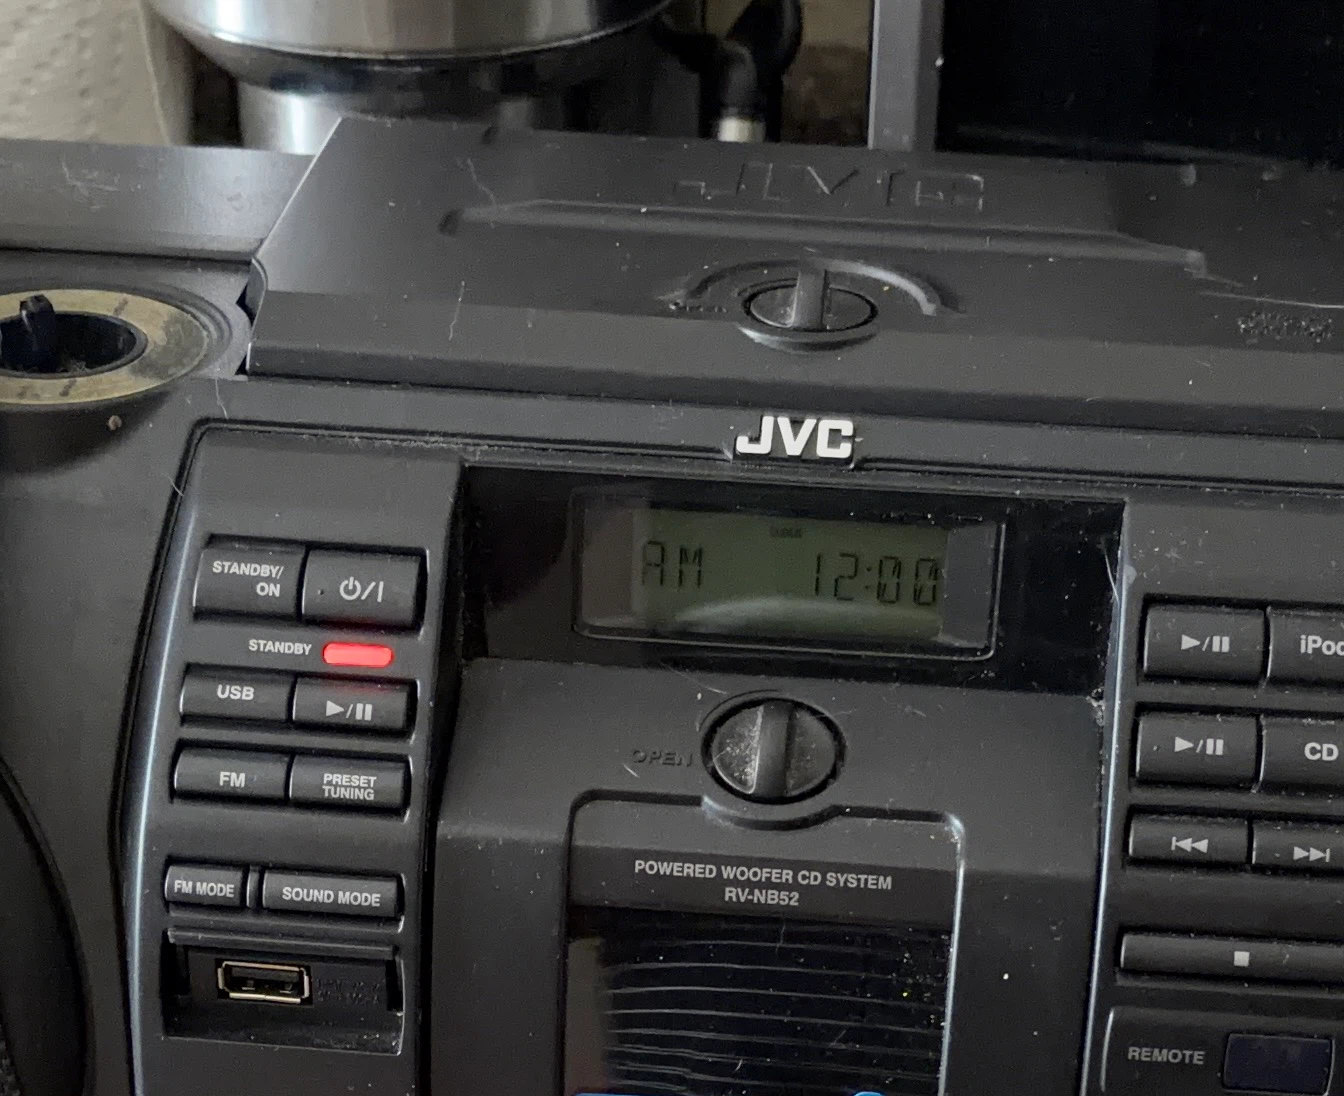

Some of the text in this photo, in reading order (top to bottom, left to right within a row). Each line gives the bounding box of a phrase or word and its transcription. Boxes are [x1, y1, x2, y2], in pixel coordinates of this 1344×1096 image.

[736, 415, 854, 459] JVC
[212, 561, 284, 579] STANDBY/
[642, 540, 940, 606] AM 12:00
[256, 582, 281, 597] ON
[248, 639, 312, 656] STANDBY
[217, 684, 255, 700] USB
[631, 747, 694, 767] OPEN
[1304, 742, 1339, 762] CD
[219, 772, 246, 787] FM
[323, 773, 377, 788] PRESET
[322, 785, 375, 801] TUNING
[634, 859, 892, 890] POWERED WOOFER CD SYSTEM
[174, 880, 235, 897] FM MODE
[282, 886, 381, 907] SOUND MODE
[724, 887, 800, 906] RV-NB52
[1127, 1046, 1206, 1065] REMOTE
